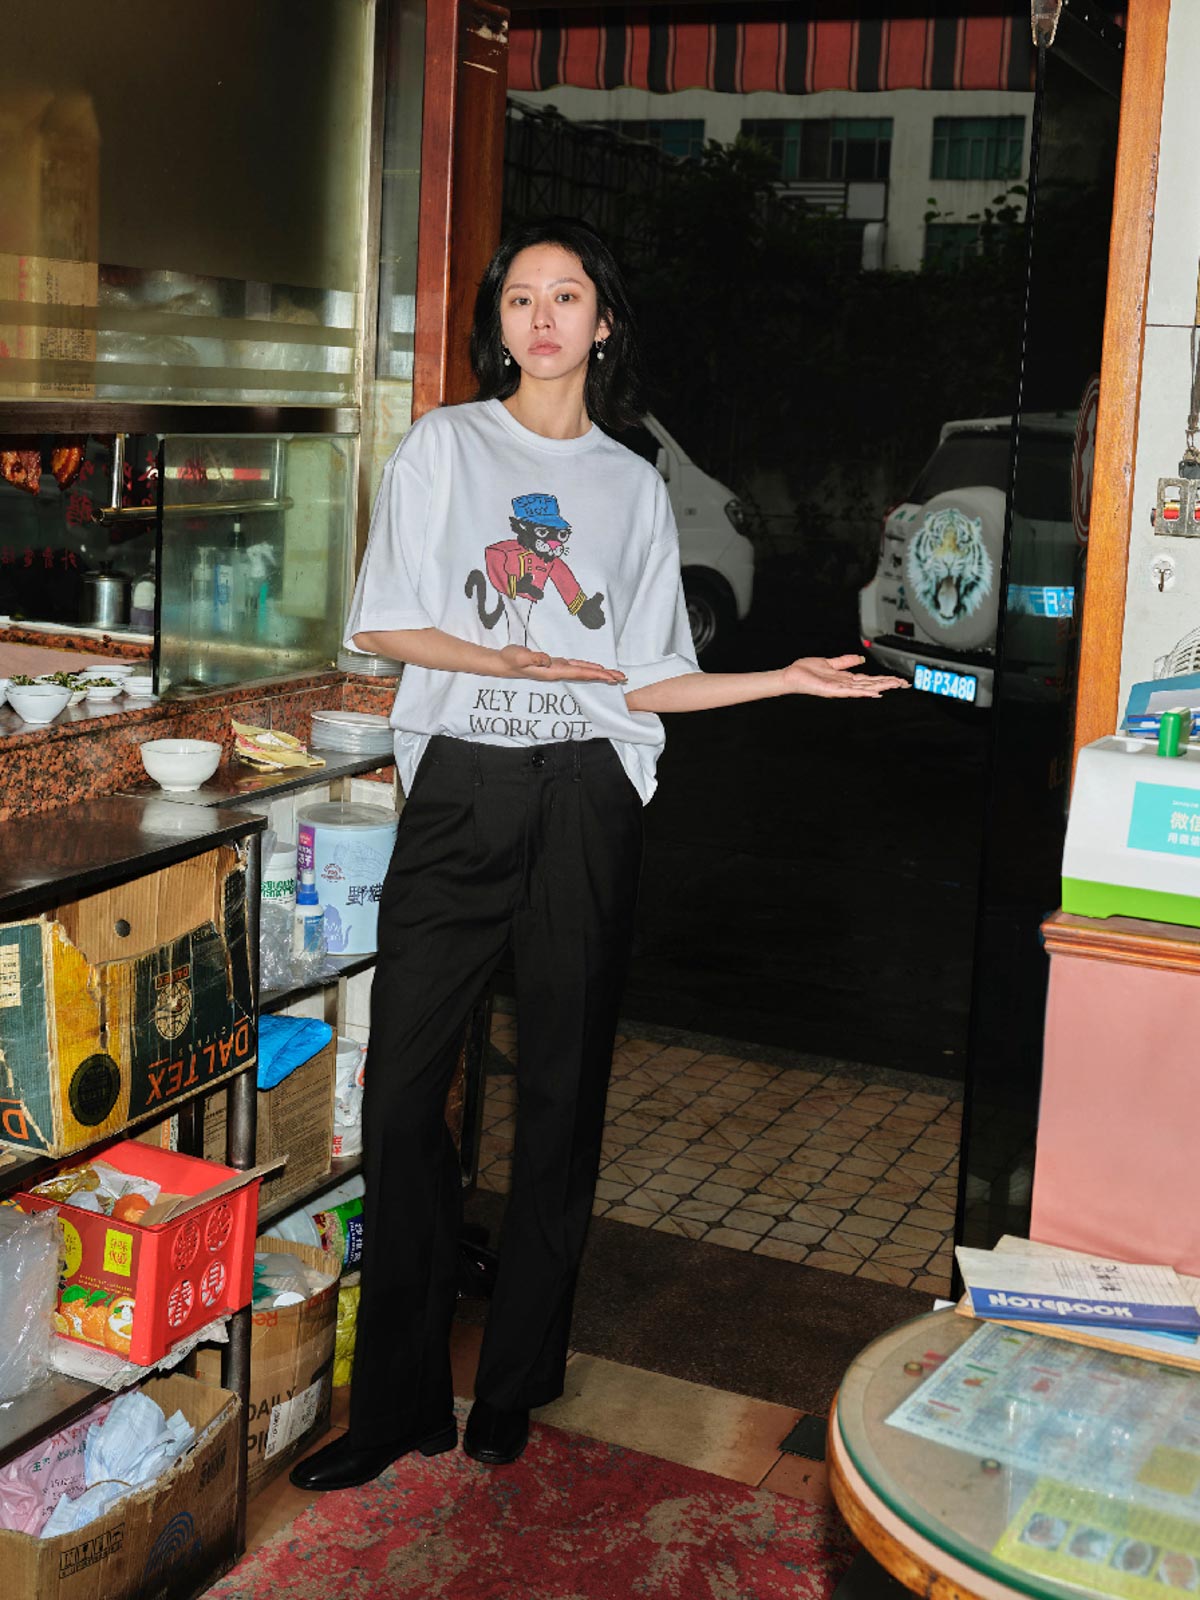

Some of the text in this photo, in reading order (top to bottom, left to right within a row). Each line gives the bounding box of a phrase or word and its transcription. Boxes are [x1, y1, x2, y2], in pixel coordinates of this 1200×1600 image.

[472, 688, 518, 713] KEY
[469, 714, 593, 740] WORK OFF
[145, 1024, 250, 1106] DALTEX
[247, 1430, 268, 1454] PI
